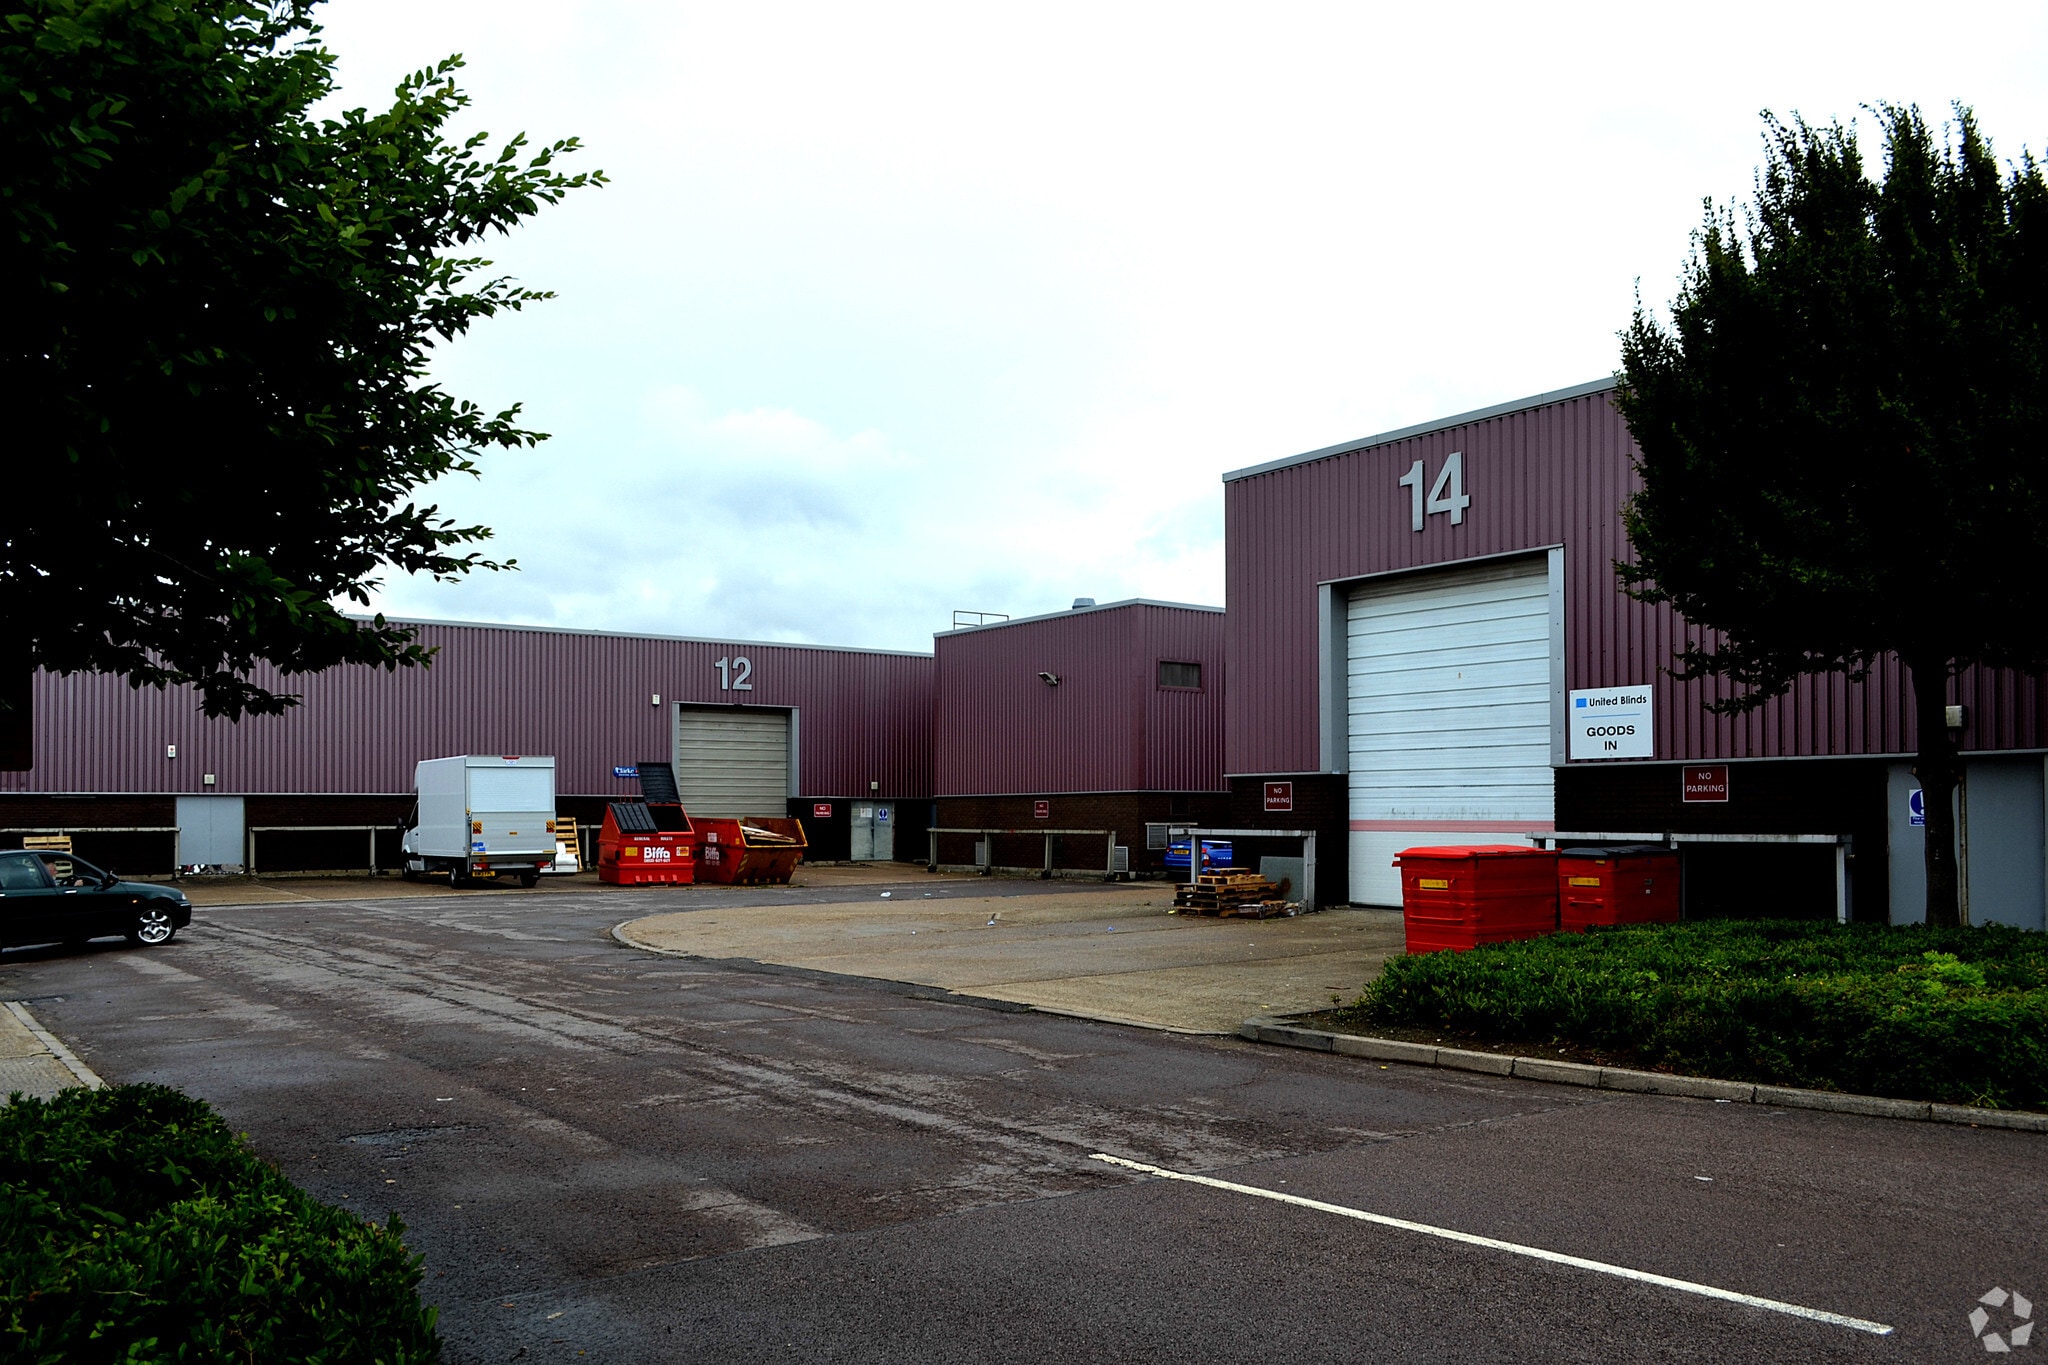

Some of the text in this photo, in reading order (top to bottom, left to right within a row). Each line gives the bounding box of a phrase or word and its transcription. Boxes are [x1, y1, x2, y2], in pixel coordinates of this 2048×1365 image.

[1399, 451, 1470, 532] 14
[714, 656, 752, 690] 12
[1589, 694, 1647, 707] United Blinds
[1586, 725, 1635, 737] GOODS
[1604, 740, 1617, 751] IN
[1698, 772, 1712, 780] NO
[1686, 784, 1725, 793] PARKING
[643, 846, 671, 859] Biffa
[705, 846, 720, 861] Biffa
